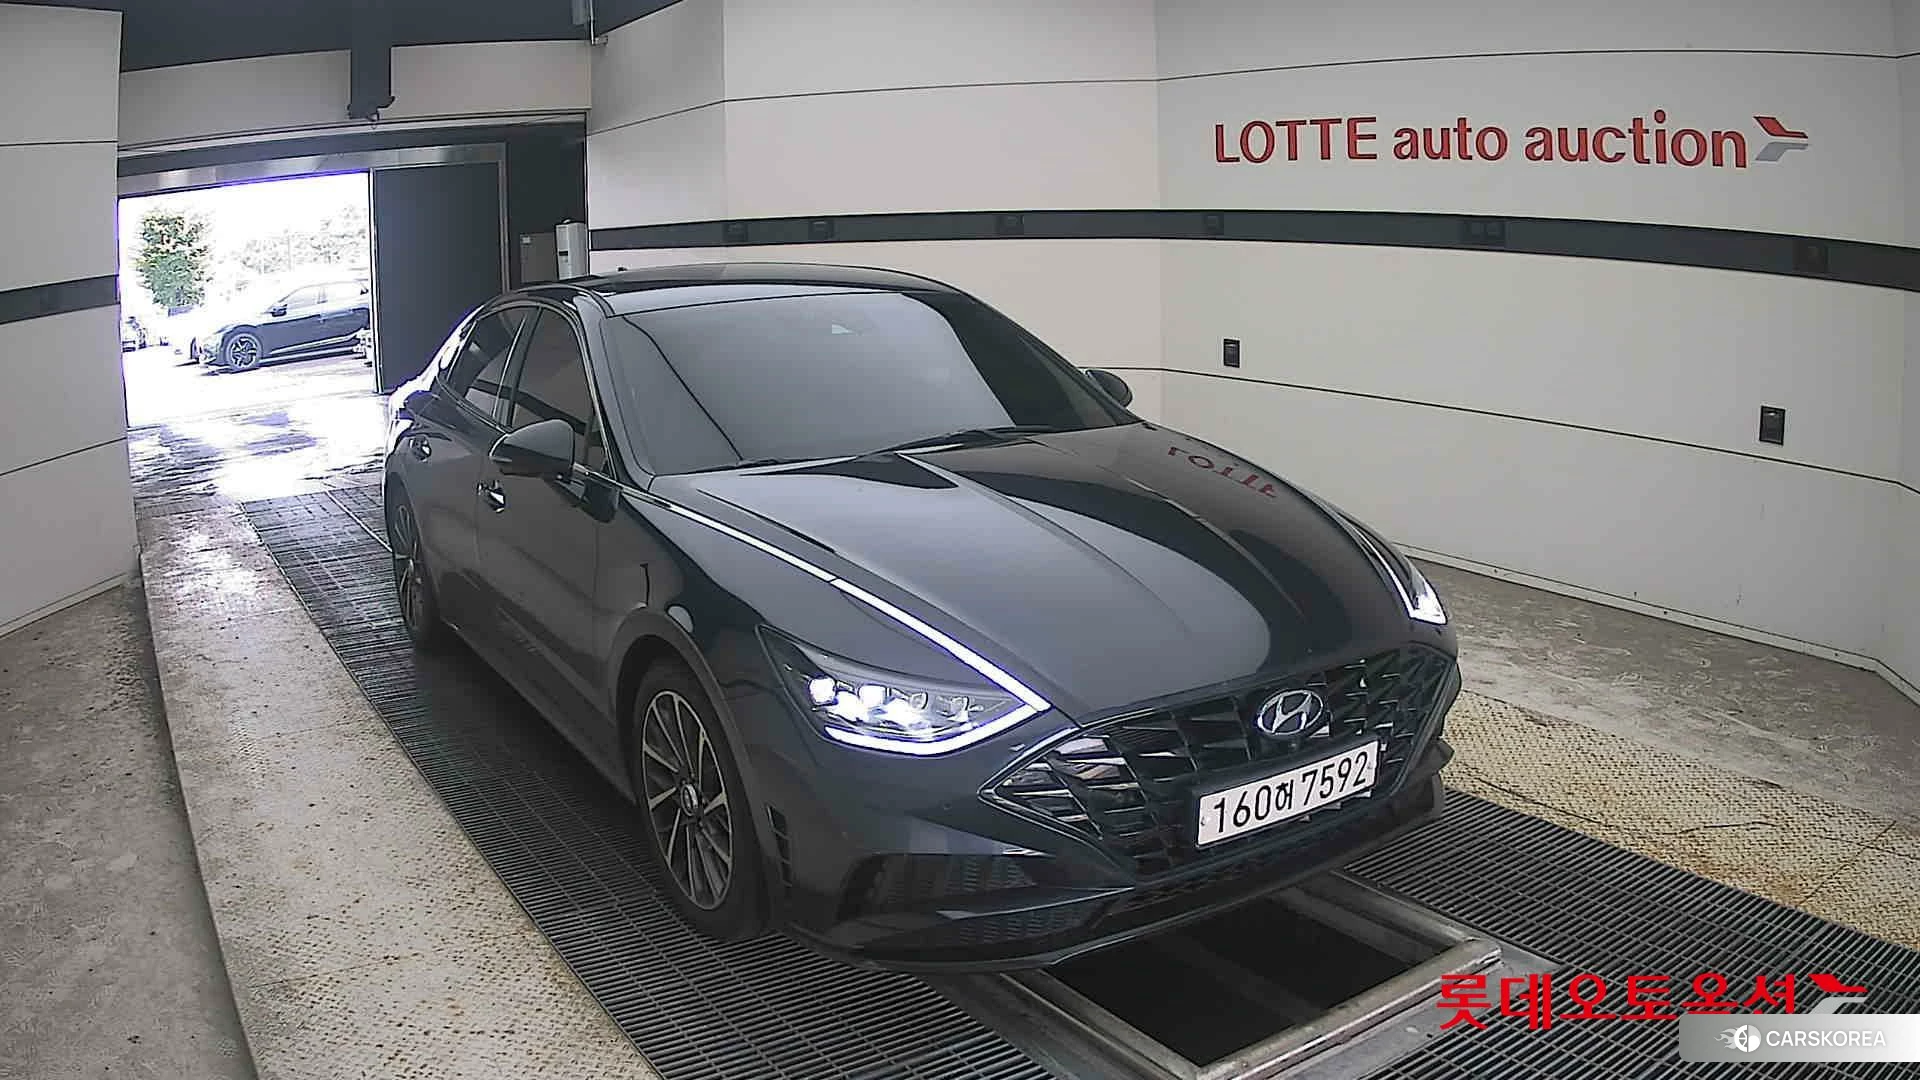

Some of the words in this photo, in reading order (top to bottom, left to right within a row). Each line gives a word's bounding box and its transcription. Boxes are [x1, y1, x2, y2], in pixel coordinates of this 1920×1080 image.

[1214, 117, 1378, 163] LOTTE
[1393, 117, 1509, 161] auto
[1524, 110, 1747, 168] auction
[1213, 779, 1295, 834] 160허
[1301, 751, 1369, 806] 7592
